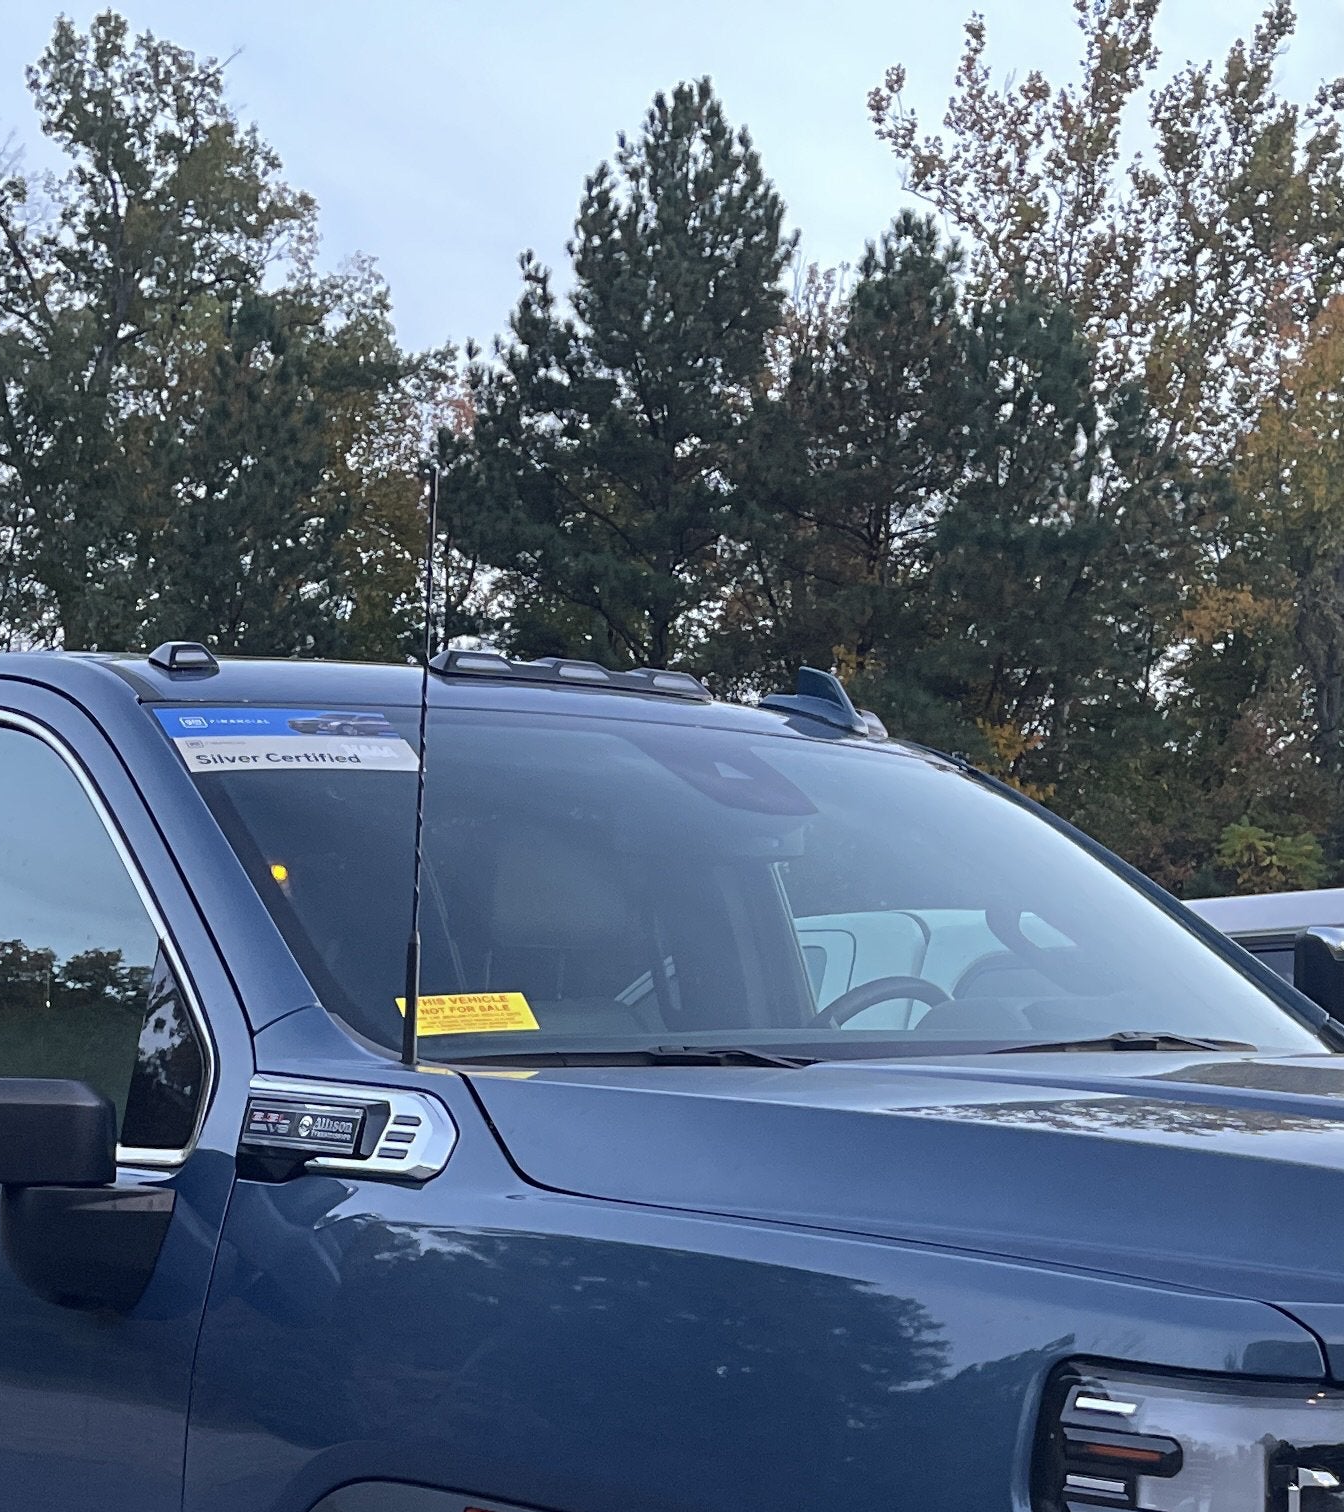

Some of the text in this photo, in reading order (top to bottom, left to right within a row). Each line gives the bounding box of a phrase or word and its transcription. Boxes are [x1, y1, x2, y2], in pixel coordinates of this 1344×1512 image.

[195, 752, 362, 766] Silver Certified
[448, 995, 509, 1005] VEHICLE
[420, 1004, 511, 1015] NOT FOR SALE
[313, 1116, 353, 1134] Allison
